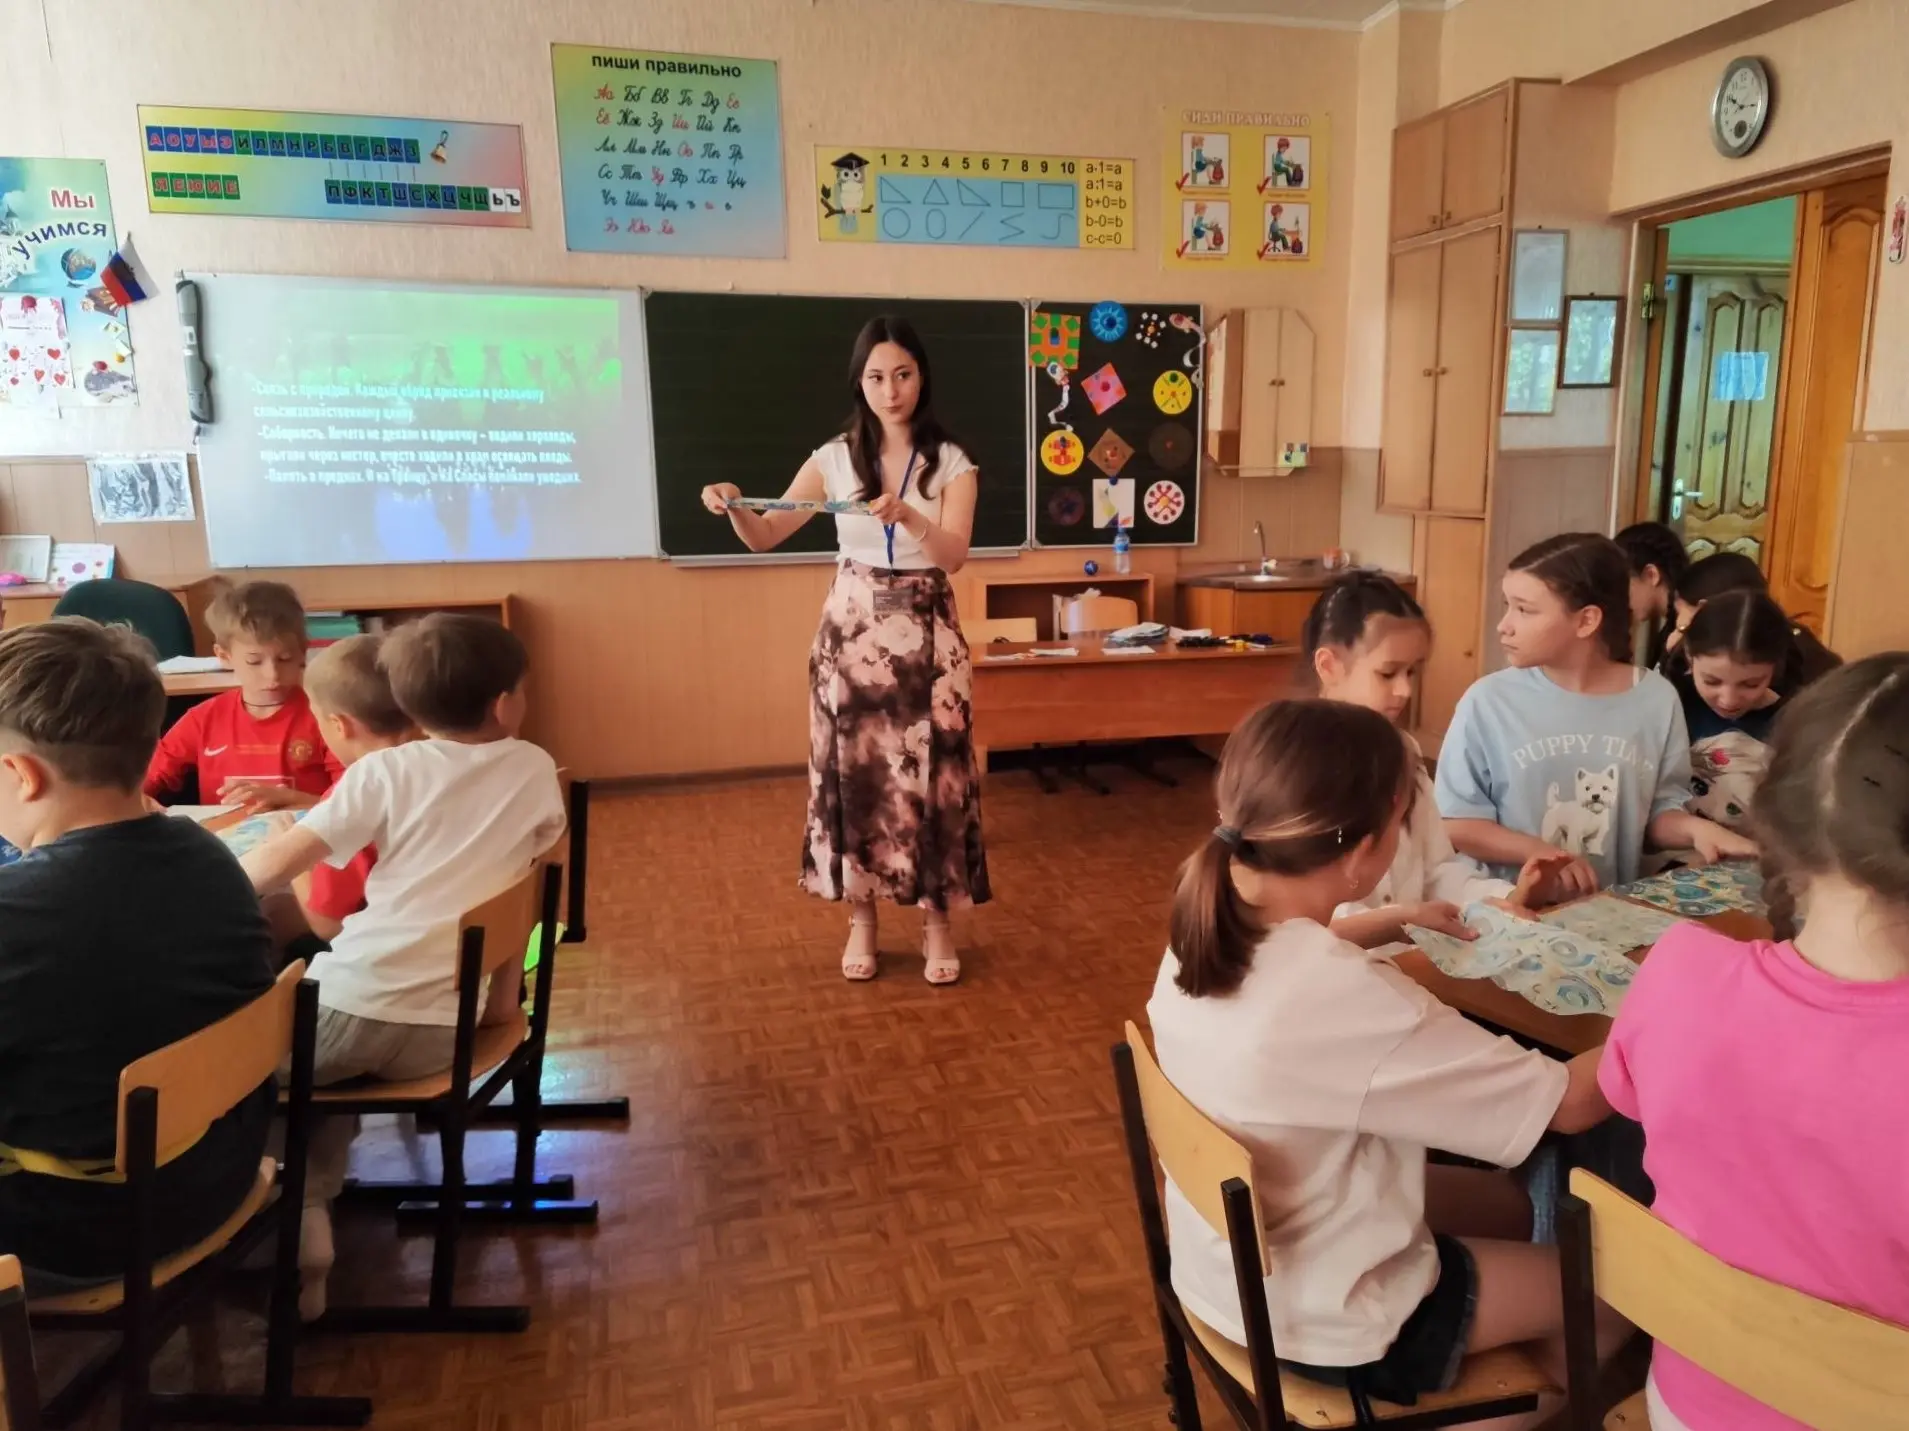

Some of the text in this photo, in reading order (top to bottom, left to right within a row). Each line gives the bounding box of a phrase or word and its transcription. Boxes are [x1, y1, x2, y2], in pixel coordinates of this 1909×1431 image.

[591, 55, 742, 78] пиши правильно
[624, 84, 646, 102] Бб
[651, 87, 669, 104] Вв
[880, 154, 1075, 175] 1 2 3 4 5 6 7 8 9 10
[51, 189, 95, 209] Мы
[1086, 195, 1127, 209] b+0=b
[12, 220, 108, 260] учимся
[1511, 733, 1594, 769] PUPPY
